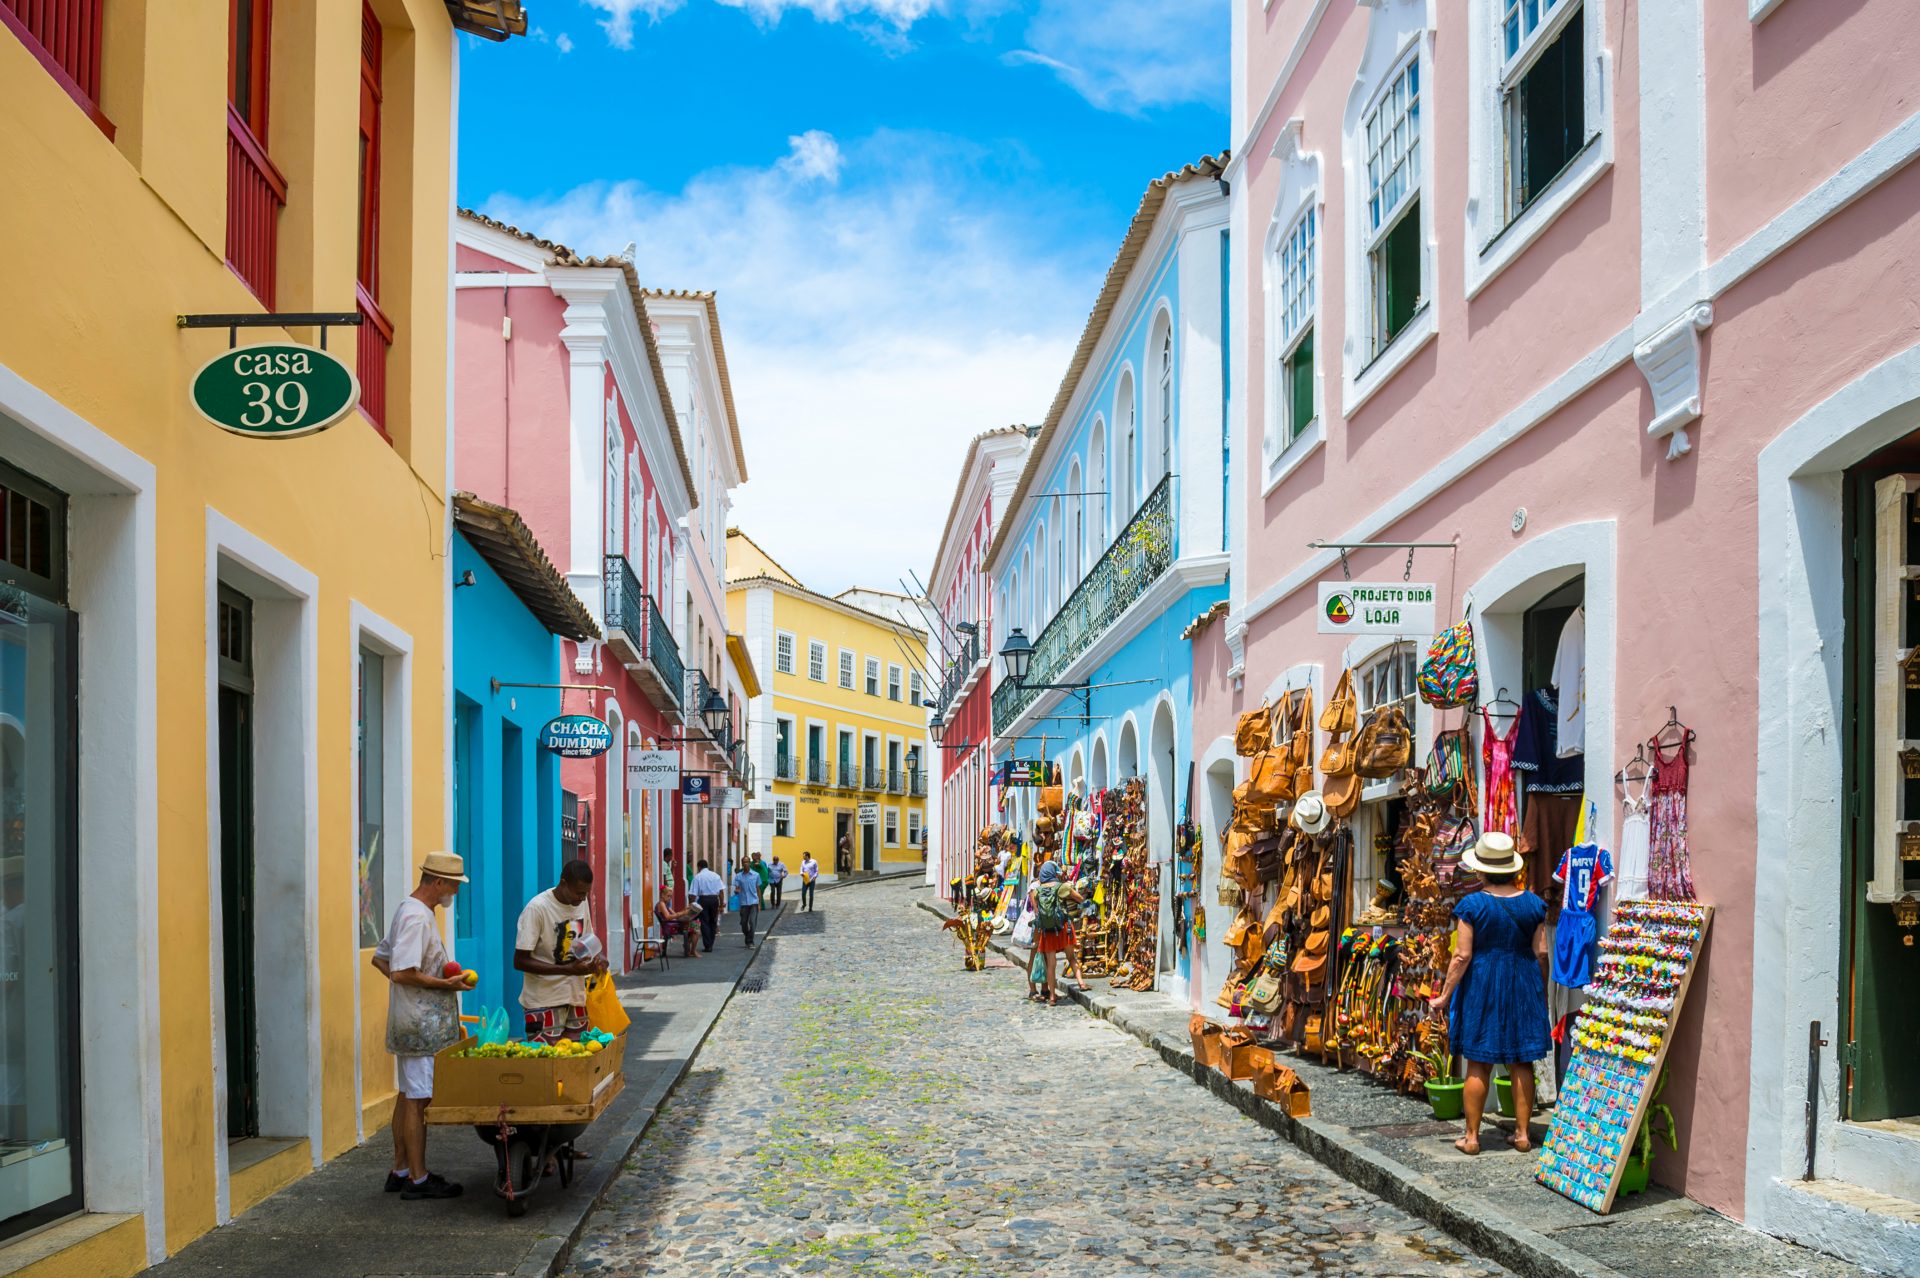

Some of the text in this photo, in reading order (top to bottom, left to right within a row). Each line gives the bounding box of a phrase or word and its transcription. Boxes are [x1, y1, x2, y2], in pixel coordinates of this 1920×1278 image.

[234, 352, 313, 376] casa
[240, 381, 308, 427] 39
[1353, 590, 1403, 601] PROJETO
[1365, 610, 1400, 624] LOJA
[1572, 858, 1593, 867] MRV
[1578, 869, 1590, 907] 9
